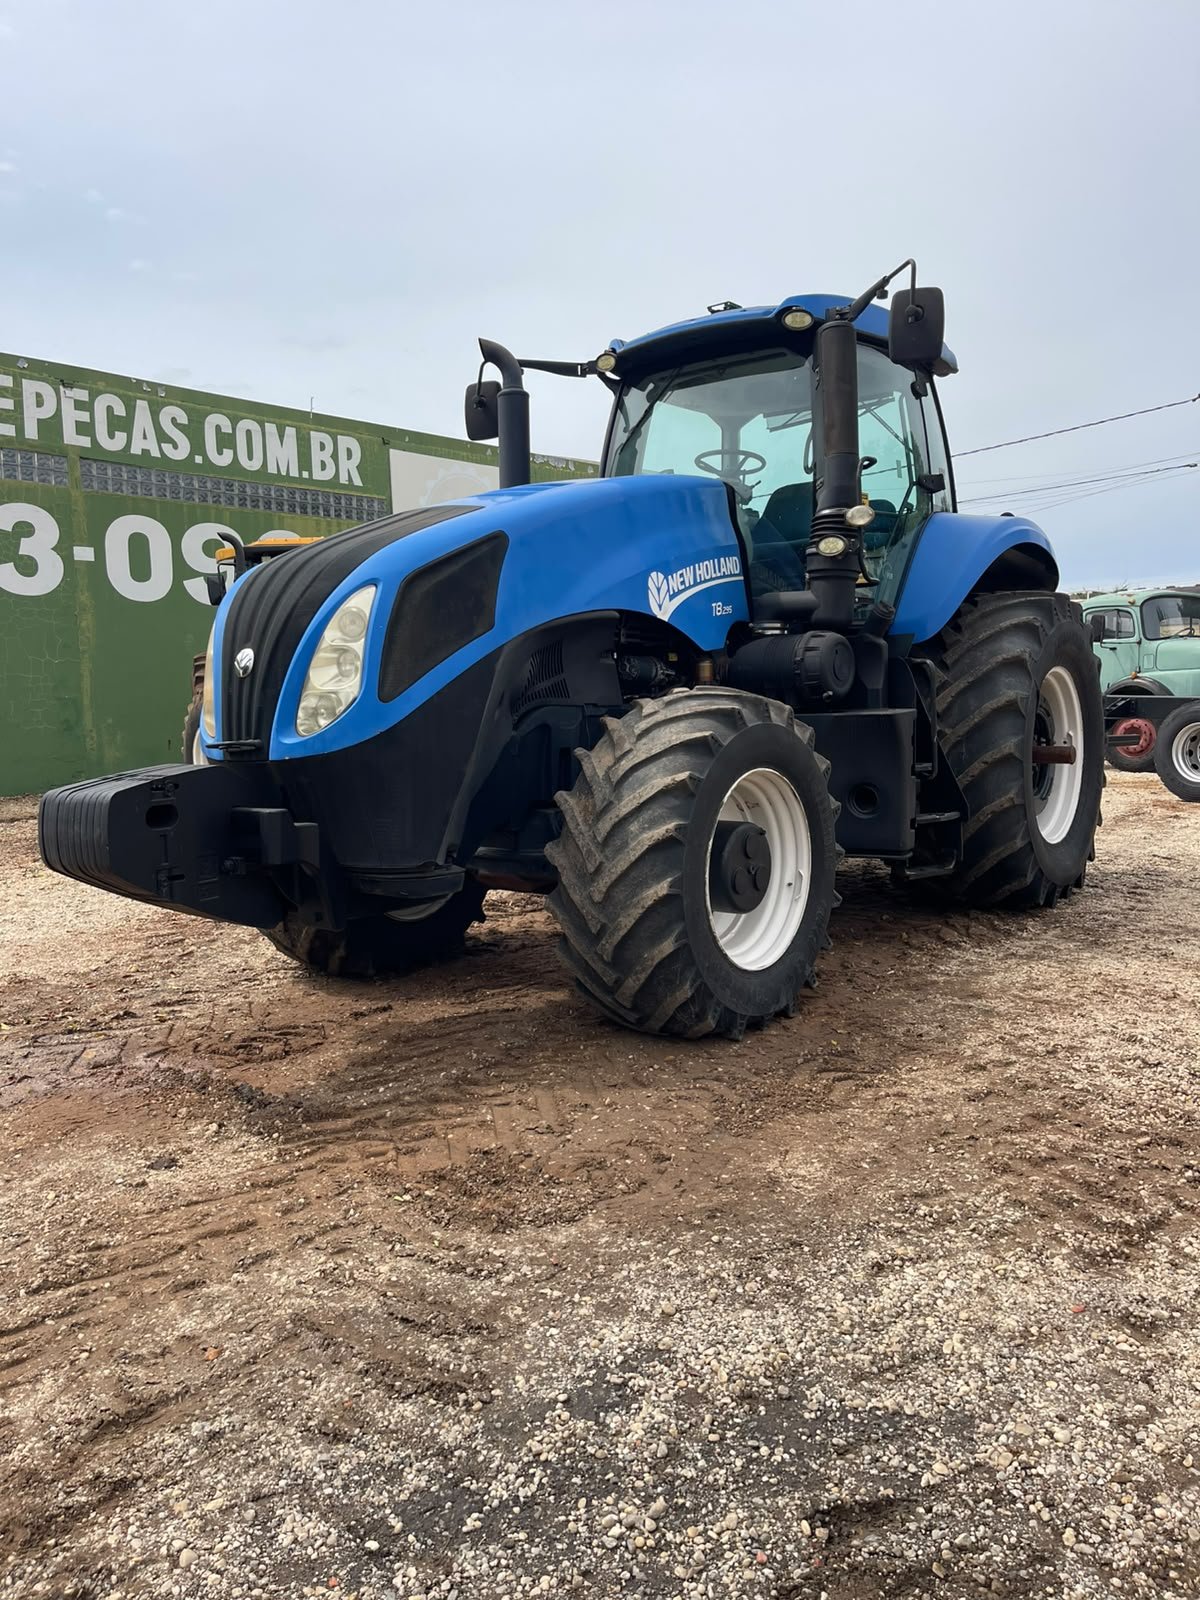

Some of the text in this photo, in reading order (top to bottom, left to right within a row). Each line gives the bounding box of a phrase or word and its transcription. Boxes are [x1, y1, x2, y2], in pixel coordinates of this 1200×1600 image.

[0, 502, 302, 606] 3-09
[668, 556, 740, 595] NEW HOLLAND
